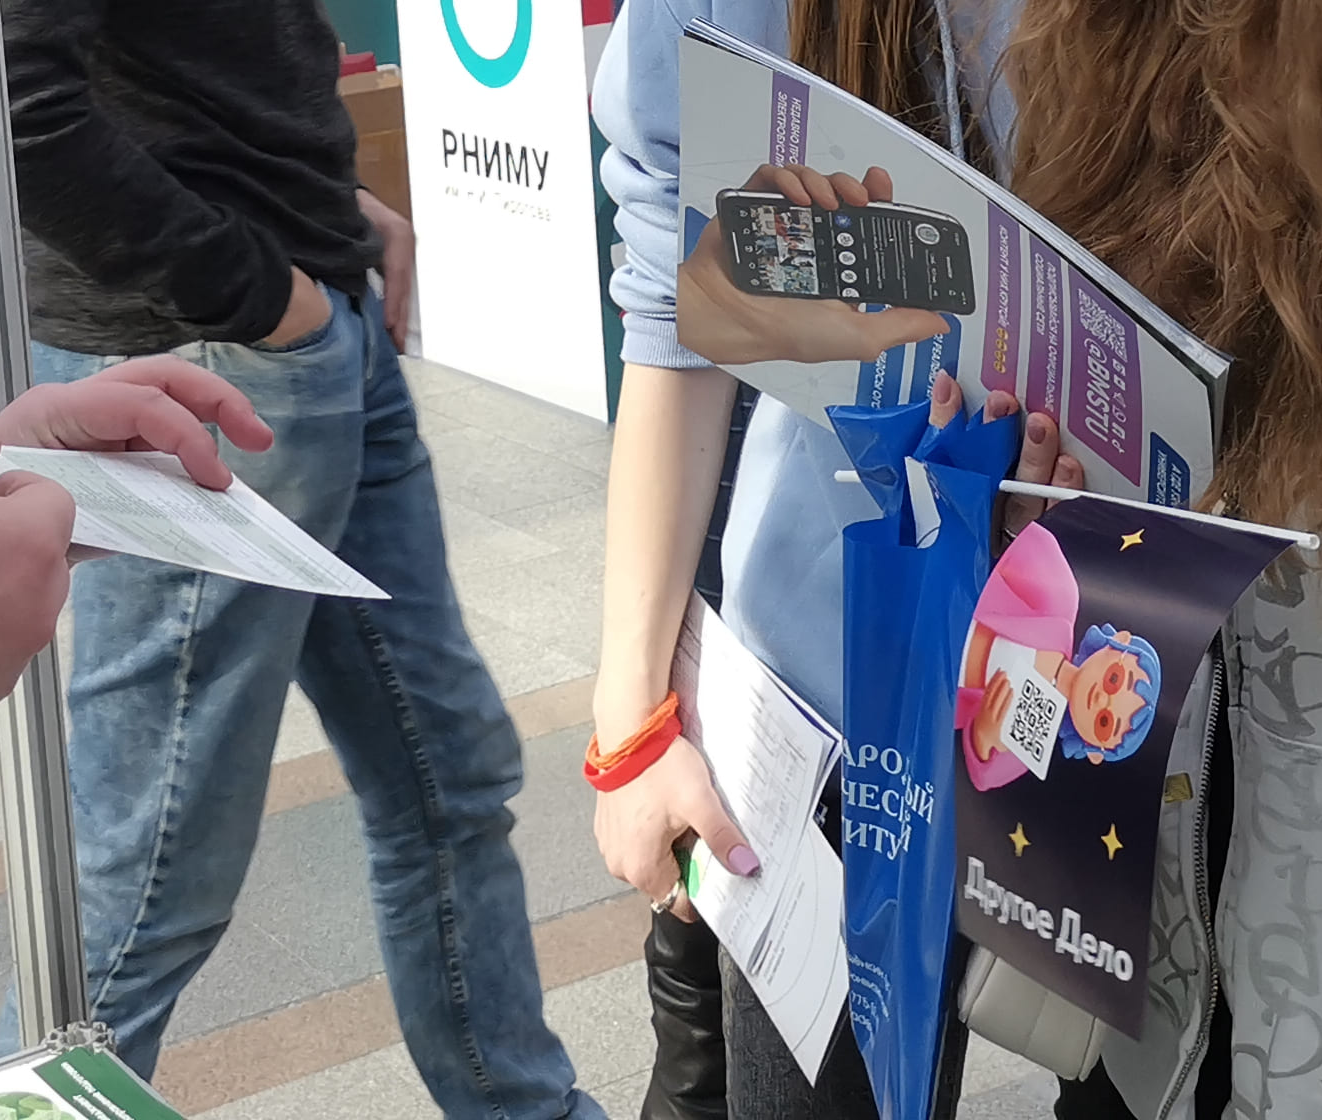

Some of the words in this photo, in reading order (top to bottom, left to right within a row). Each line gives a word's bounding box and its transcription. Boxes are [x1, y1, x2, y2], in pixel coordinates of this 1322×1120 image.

[775, 90, 788, 155] ЭЛЕКТРОБУС
[789, 97, 802, 145] НЕДАВНО
[442, 127, 549, 191] РНИМУ
[1084, 338, 1110, 442] @BMSTU
[964, 855, 1055, 940] Другое
[1054, 907, 1134, 982] Дело
